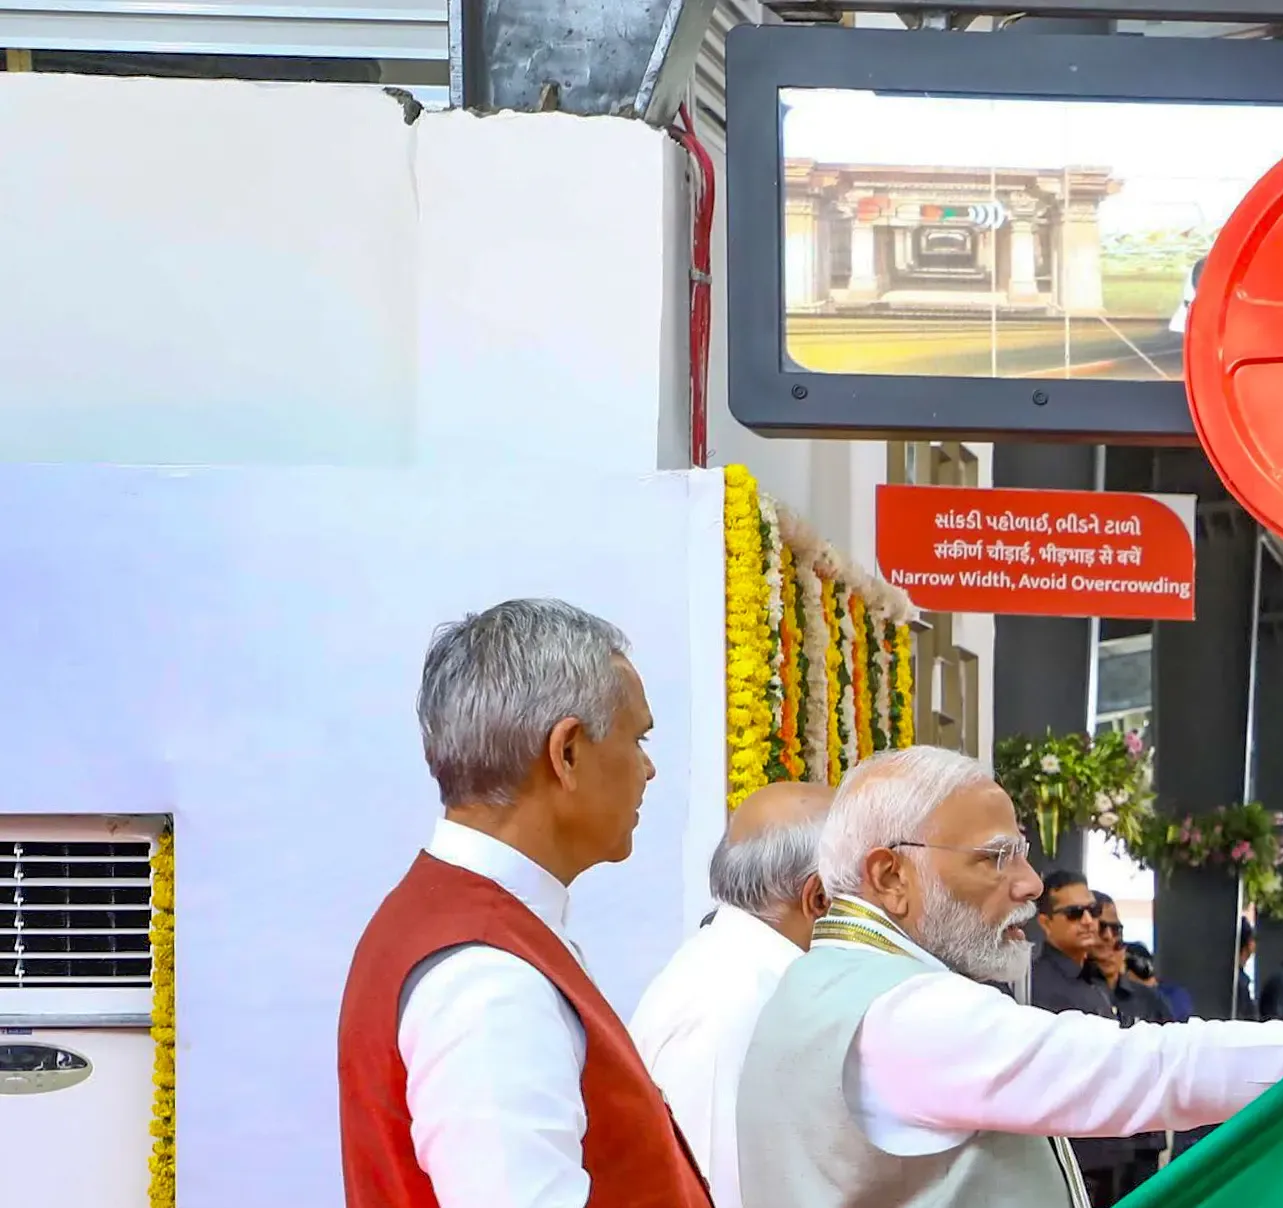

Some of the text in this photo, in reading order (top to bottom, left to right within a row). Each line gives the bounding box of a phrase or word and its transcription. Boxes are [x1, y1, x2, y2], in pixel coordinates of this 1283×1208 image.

[1055, 513, 1101, 535] ભીડને
[1104, 515, 1142, 536] ટાળો
[1098, 544, 1114, 565] से
[891, 569, 1190, 599] Narrow Width, Avoid Overcrowding
